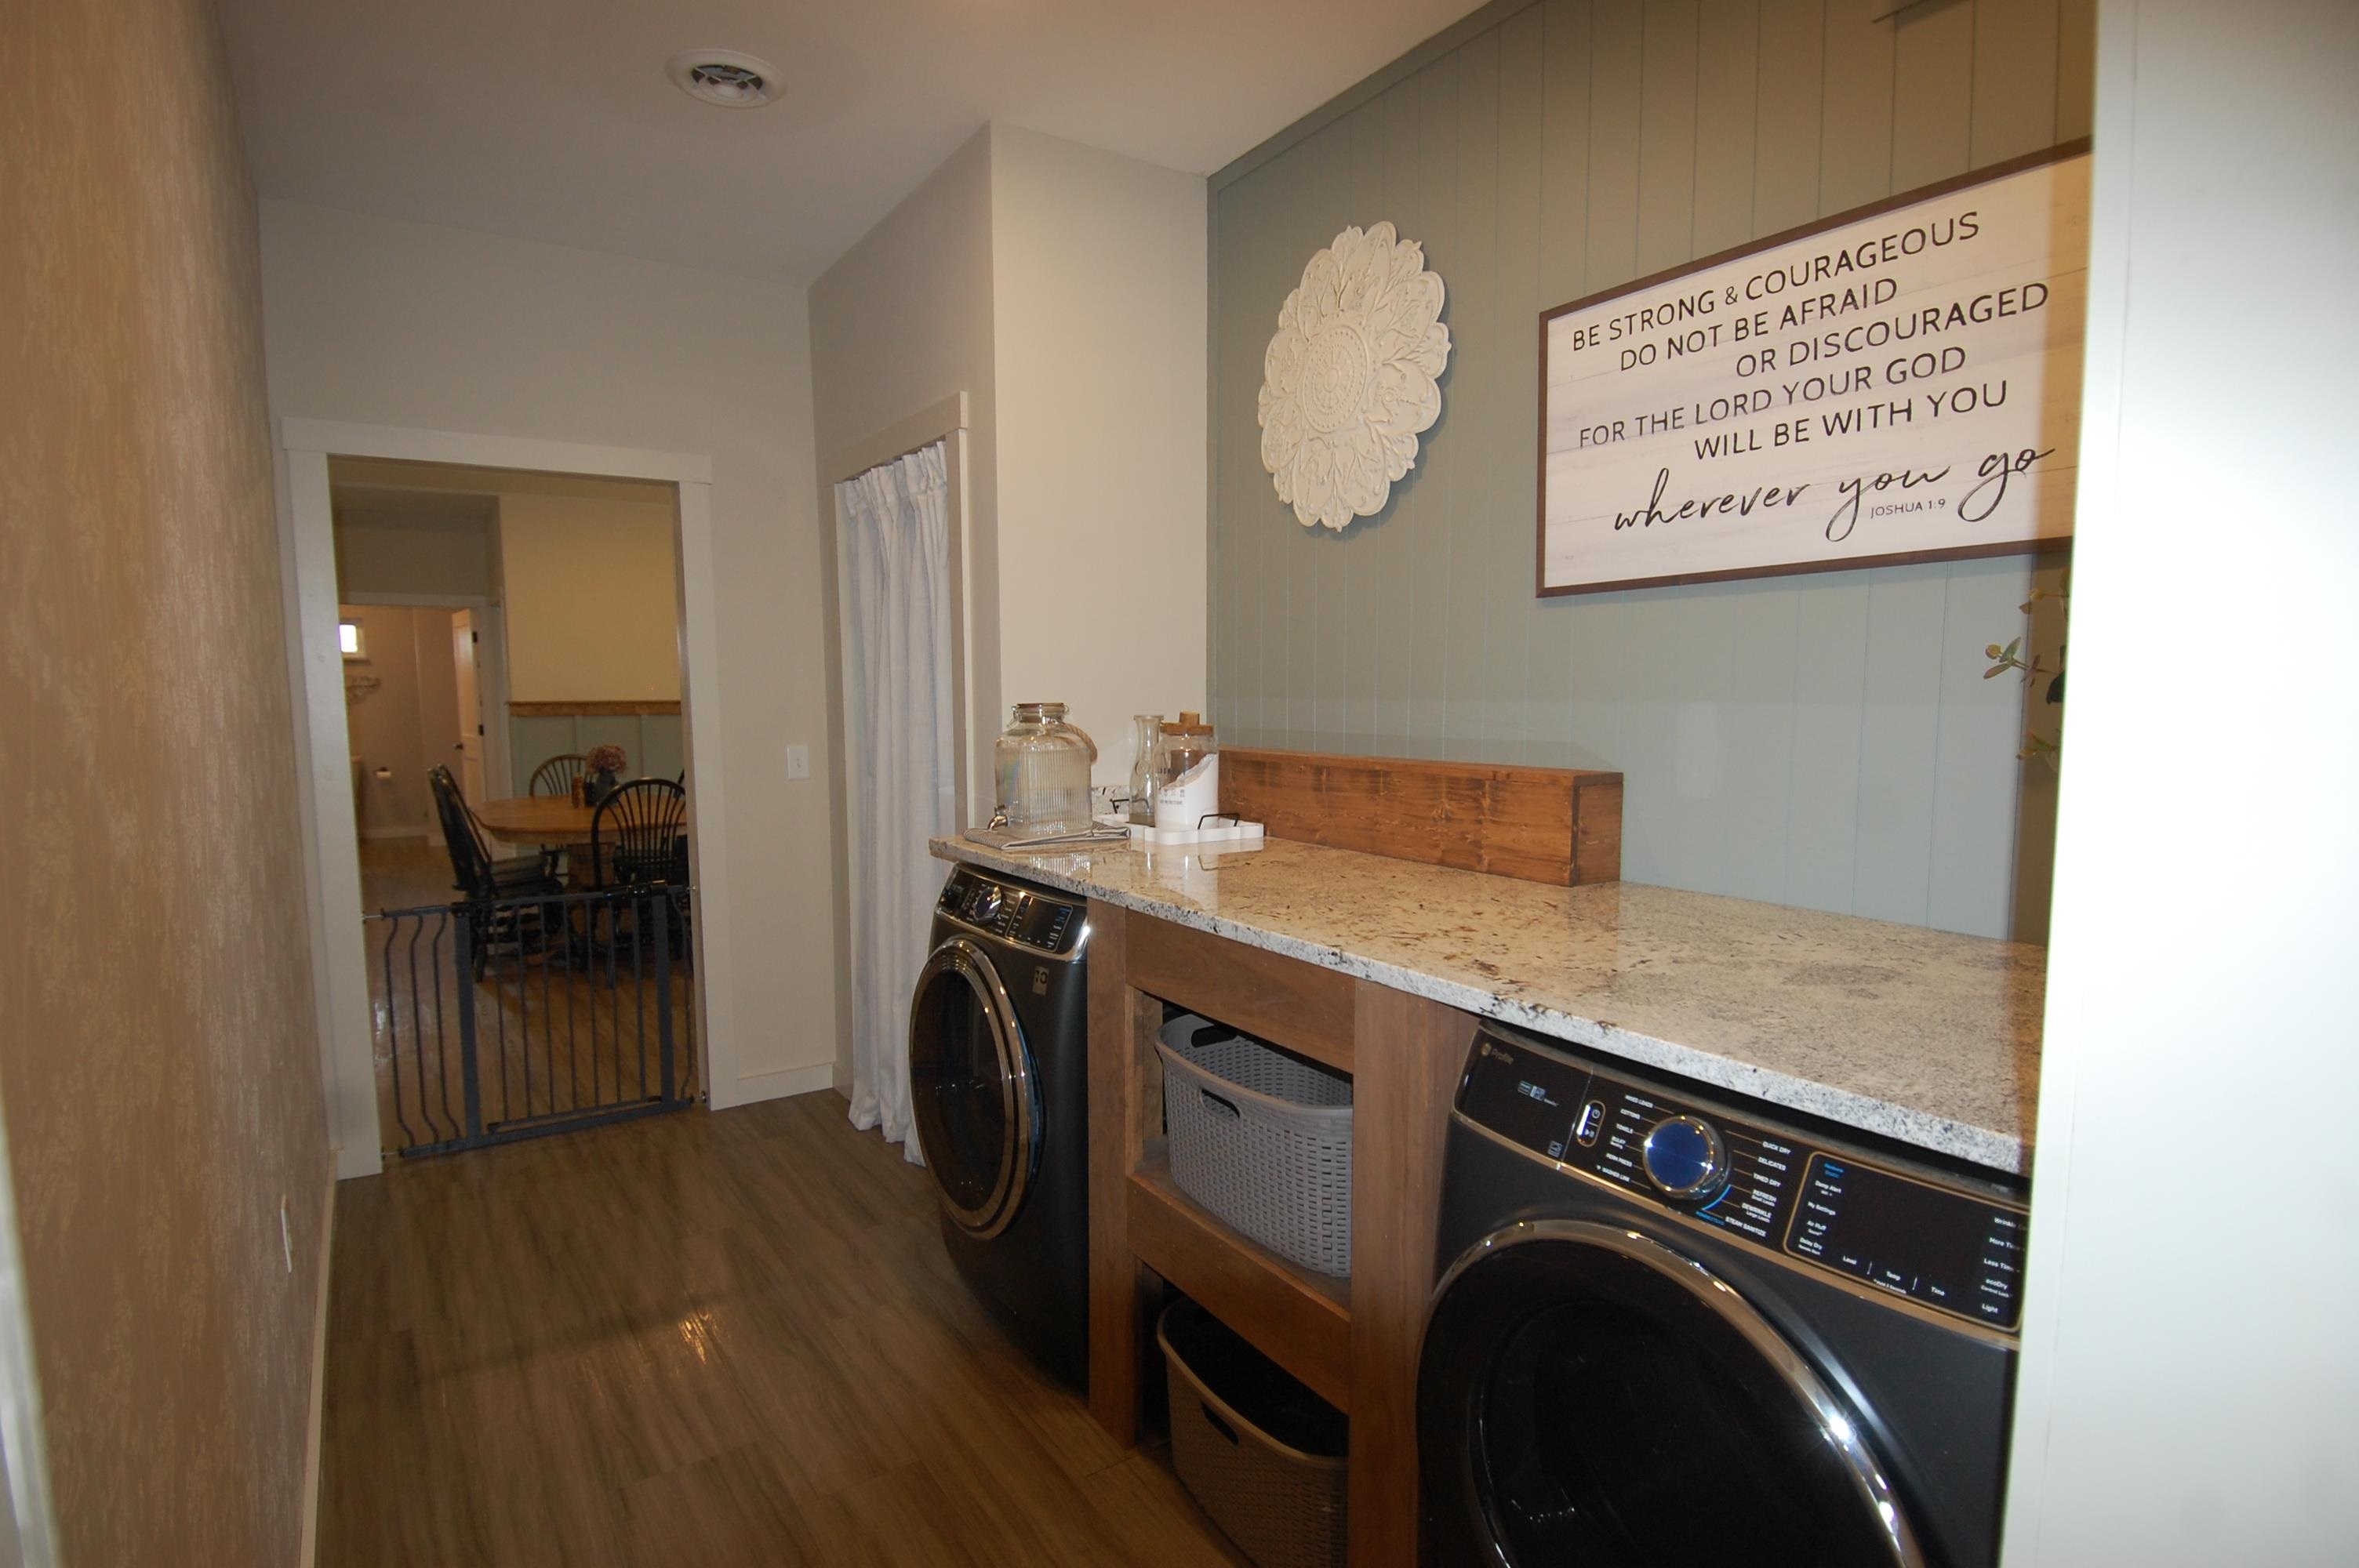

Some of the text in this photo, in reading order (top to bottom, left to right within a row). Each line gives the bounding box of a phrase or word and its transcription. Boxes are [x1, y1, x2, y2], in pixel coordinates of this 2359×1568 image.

[1573, 211, 1979, 352] BE STRONG & COURAGEOUS
[1620, 278, 1898, 372] DO NOT BE AFRAID
[1736, 281, 2049, 378] OR DISCOURAGED
[1579, 346, 1967, 448] FOR THE LORD YOUR GOD
[1694, 379, 2008, 460] WILL BE WITH YOU
[1614, 446, 2056, 543] wherever you go
[1870, 498, 1946, 519] JOSHUA 1:9
[1989, 1237, 2005, 1247] More
[1982, 1303, 1999, 1314] Light
